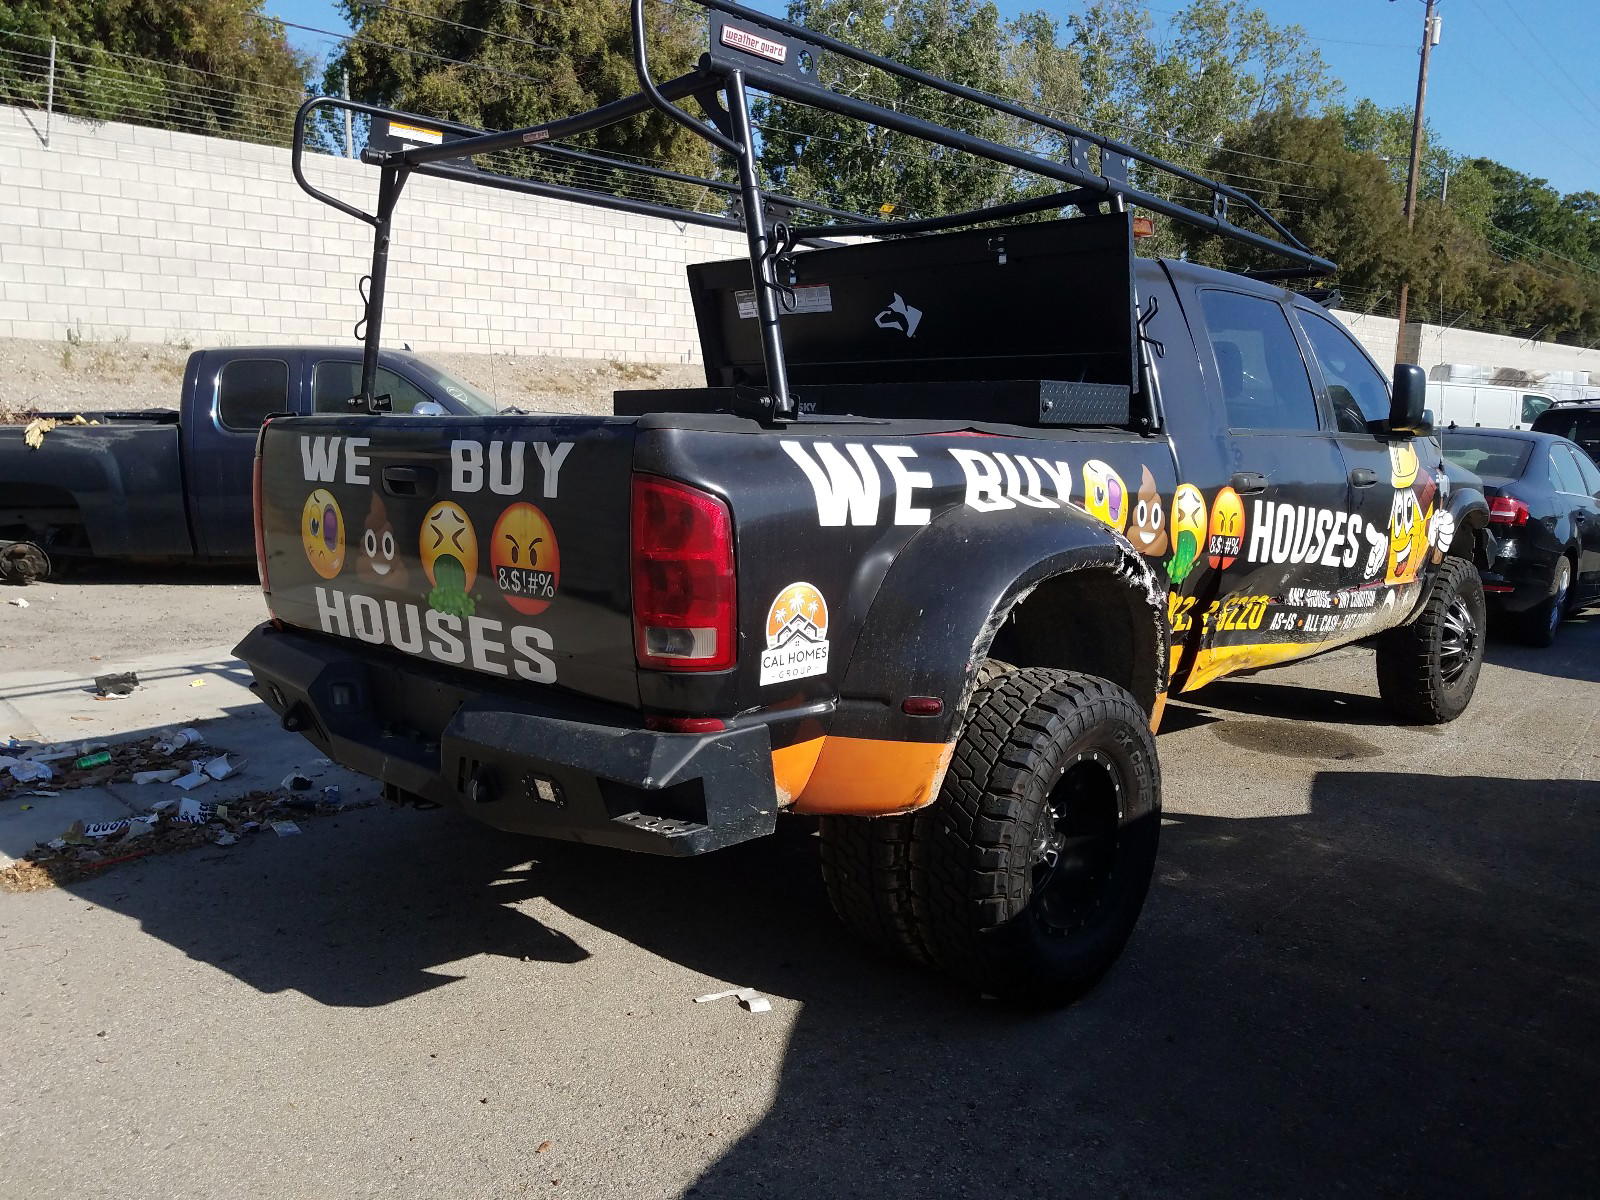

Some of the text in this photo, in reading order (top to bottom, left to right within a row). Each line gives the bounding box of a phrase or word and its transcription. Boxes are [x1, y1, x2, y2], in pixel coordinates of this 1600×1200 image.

[725, 30, 783, 56] weather guard
[301, 436, 575, 498] WE BUY
[780, 440, 1073, 527] WE BUY
[1248, 499, 1363, 568] HOUSES
[315, 587, 558, 684] HOUSES
[1269, 612, 1298, 631] AS-IS
[1303, 614, 1320, 632] ALL
[763, 647, 827, 669] CAL HOMES
